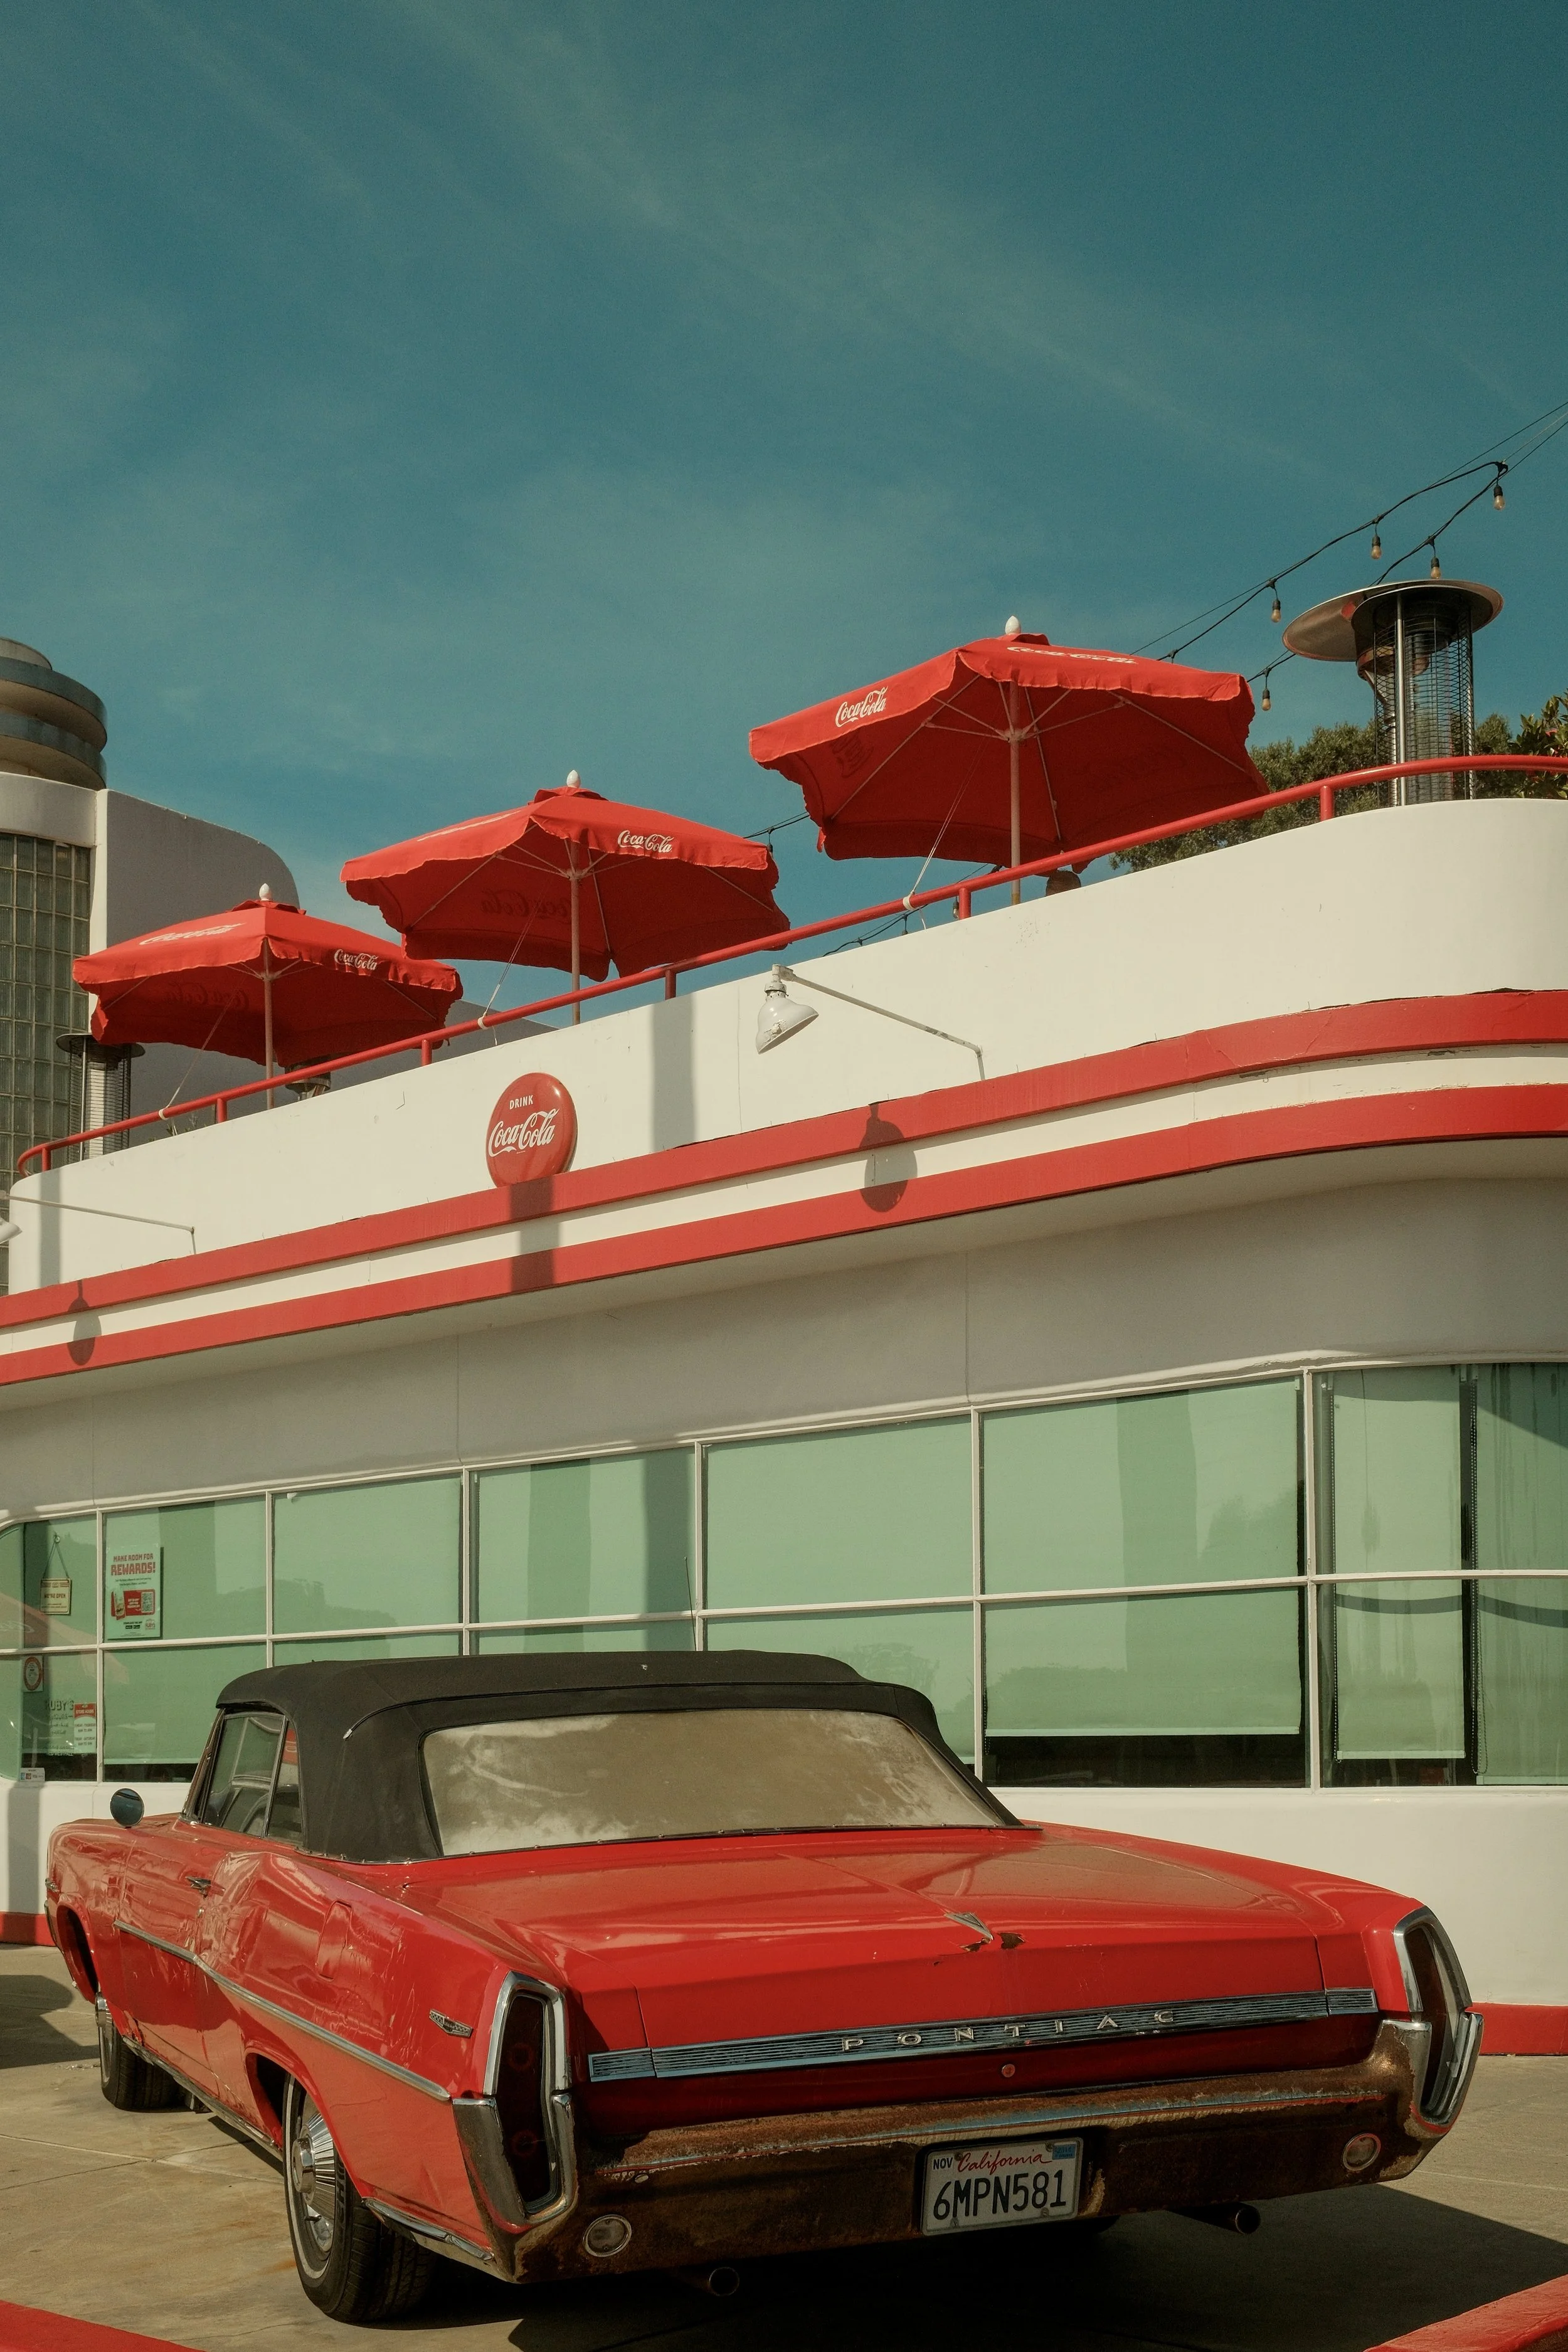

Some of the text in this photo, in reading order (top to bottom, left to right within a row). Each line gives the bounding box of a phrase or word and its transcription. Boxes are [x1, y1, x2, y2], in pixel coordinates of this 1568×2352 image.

[835, 686, 888, 728] Coca-Cola
[618, 830, 674, 853] Coca-Cola
[334, 949, 379, 970] Coca-Cola
[509, 1094, 534, 1110] DRINK
[488, 1108, 560, 1157] Coca-Cola
[110, 1562, 156, 1576] REWARDS!
[842, 2010, 1174, 2052] PONTIAC
[933, 2156, 953, 2170] NOV
[957, 2149, 1052, 2176] California
[933, 2169, 1067, 2220] 6MPN581
